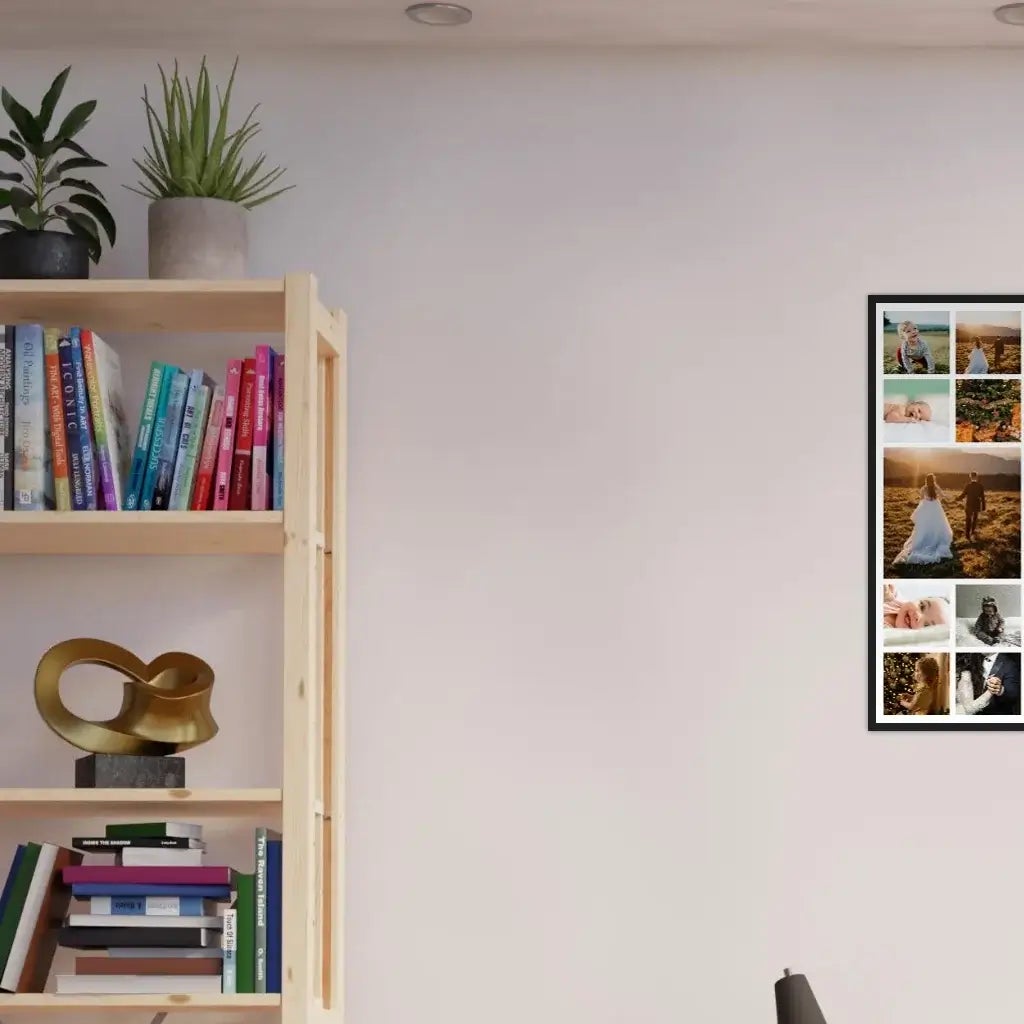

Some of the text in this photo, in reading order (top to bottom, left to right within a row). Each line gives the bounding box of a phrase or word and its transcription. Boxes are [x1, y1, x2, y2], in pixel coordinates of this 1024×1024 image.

[21, 342, 33, 405] Oil Paintings
[49, 365, 57, 383] FINE
[51, 384, 59, 399] ART
[62, 361, 77, 430] ICONIC
[52, 405, 61, 422] With
[79, 415, 88, 430] ART
[52, 423, 64, 446] Digital
[55, 448, 65, 466] Tools
[83, 462, 93, 497] NORMAN
[257, 836, 265, 926] The Raven Island
[226, 913, 234, 930] Touch
